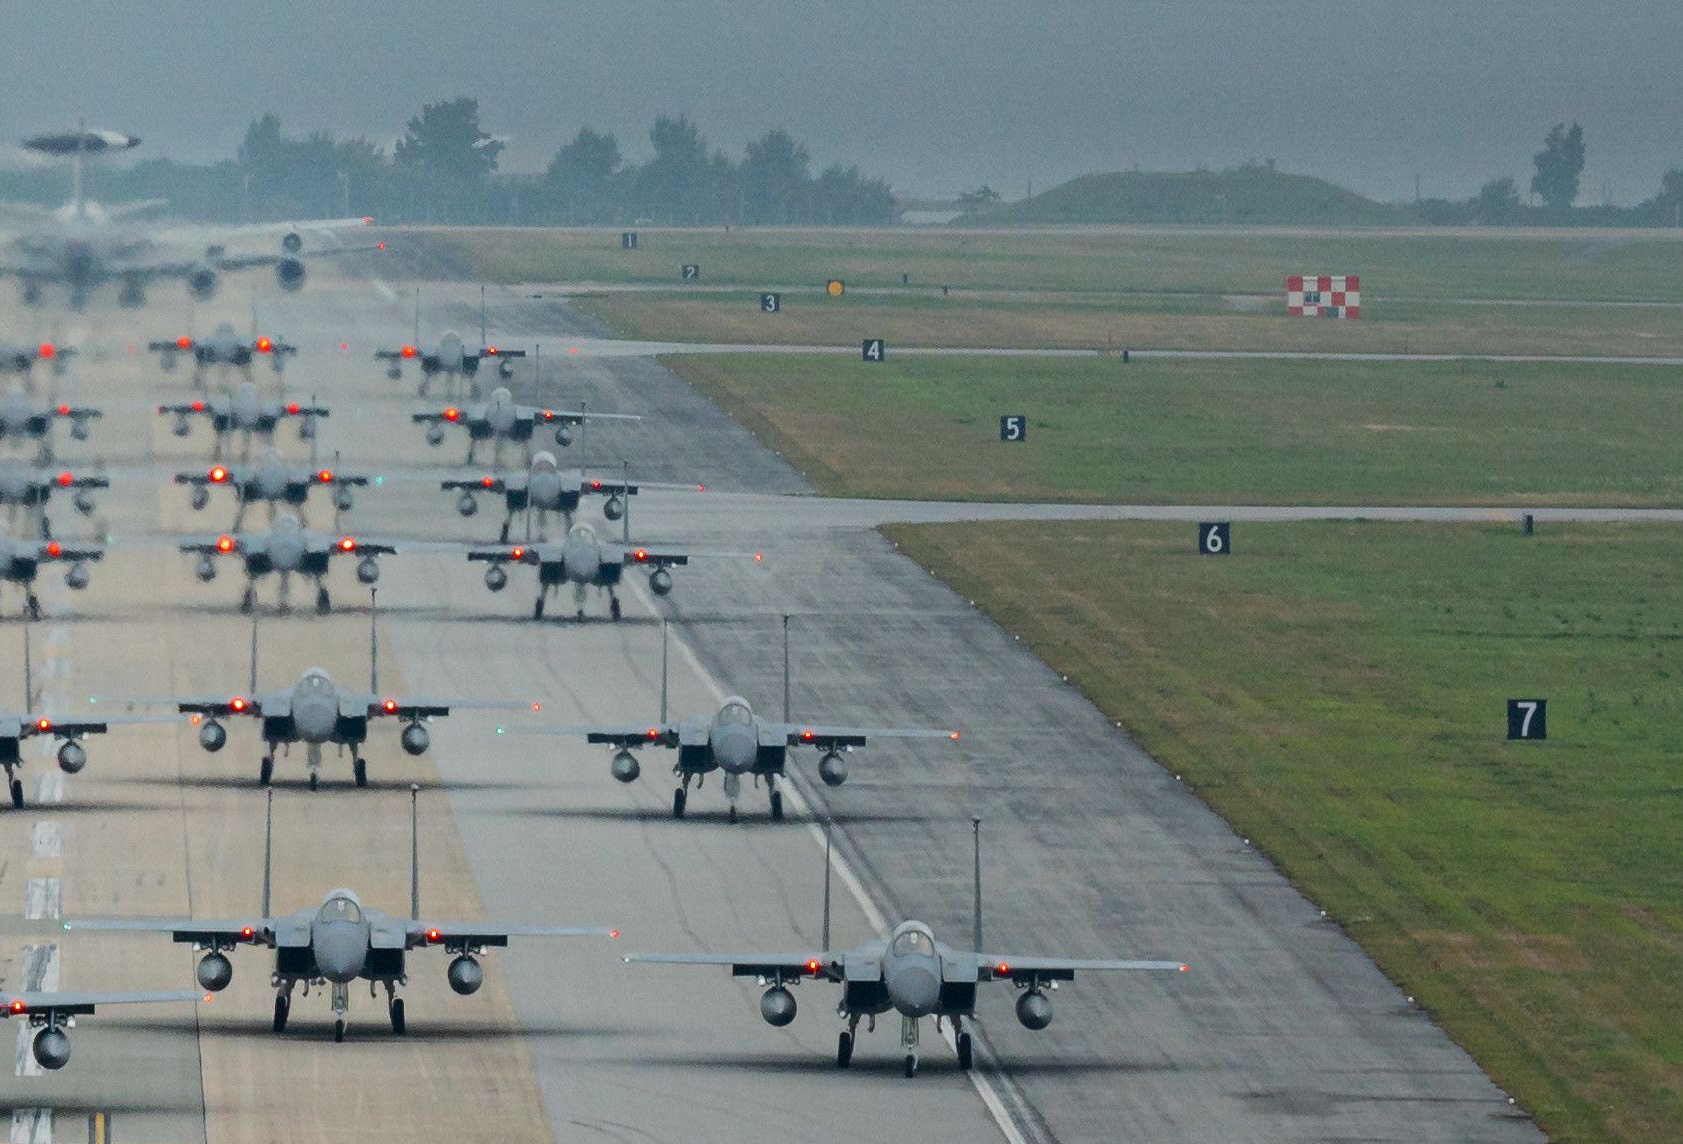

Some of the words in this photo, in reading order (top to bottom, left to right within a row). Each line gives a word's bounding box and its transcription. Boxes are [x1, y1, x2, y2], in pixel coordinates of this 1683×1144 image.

[687, 266, 695, 279] 2
[765, 295, 775, 312] 3
[867, 341, 879, 359] 4
[1007, 417, 1020, 440] 5
[1206, 525, 1223, 552] 6
[1517, 702, 1538, 737] 7
